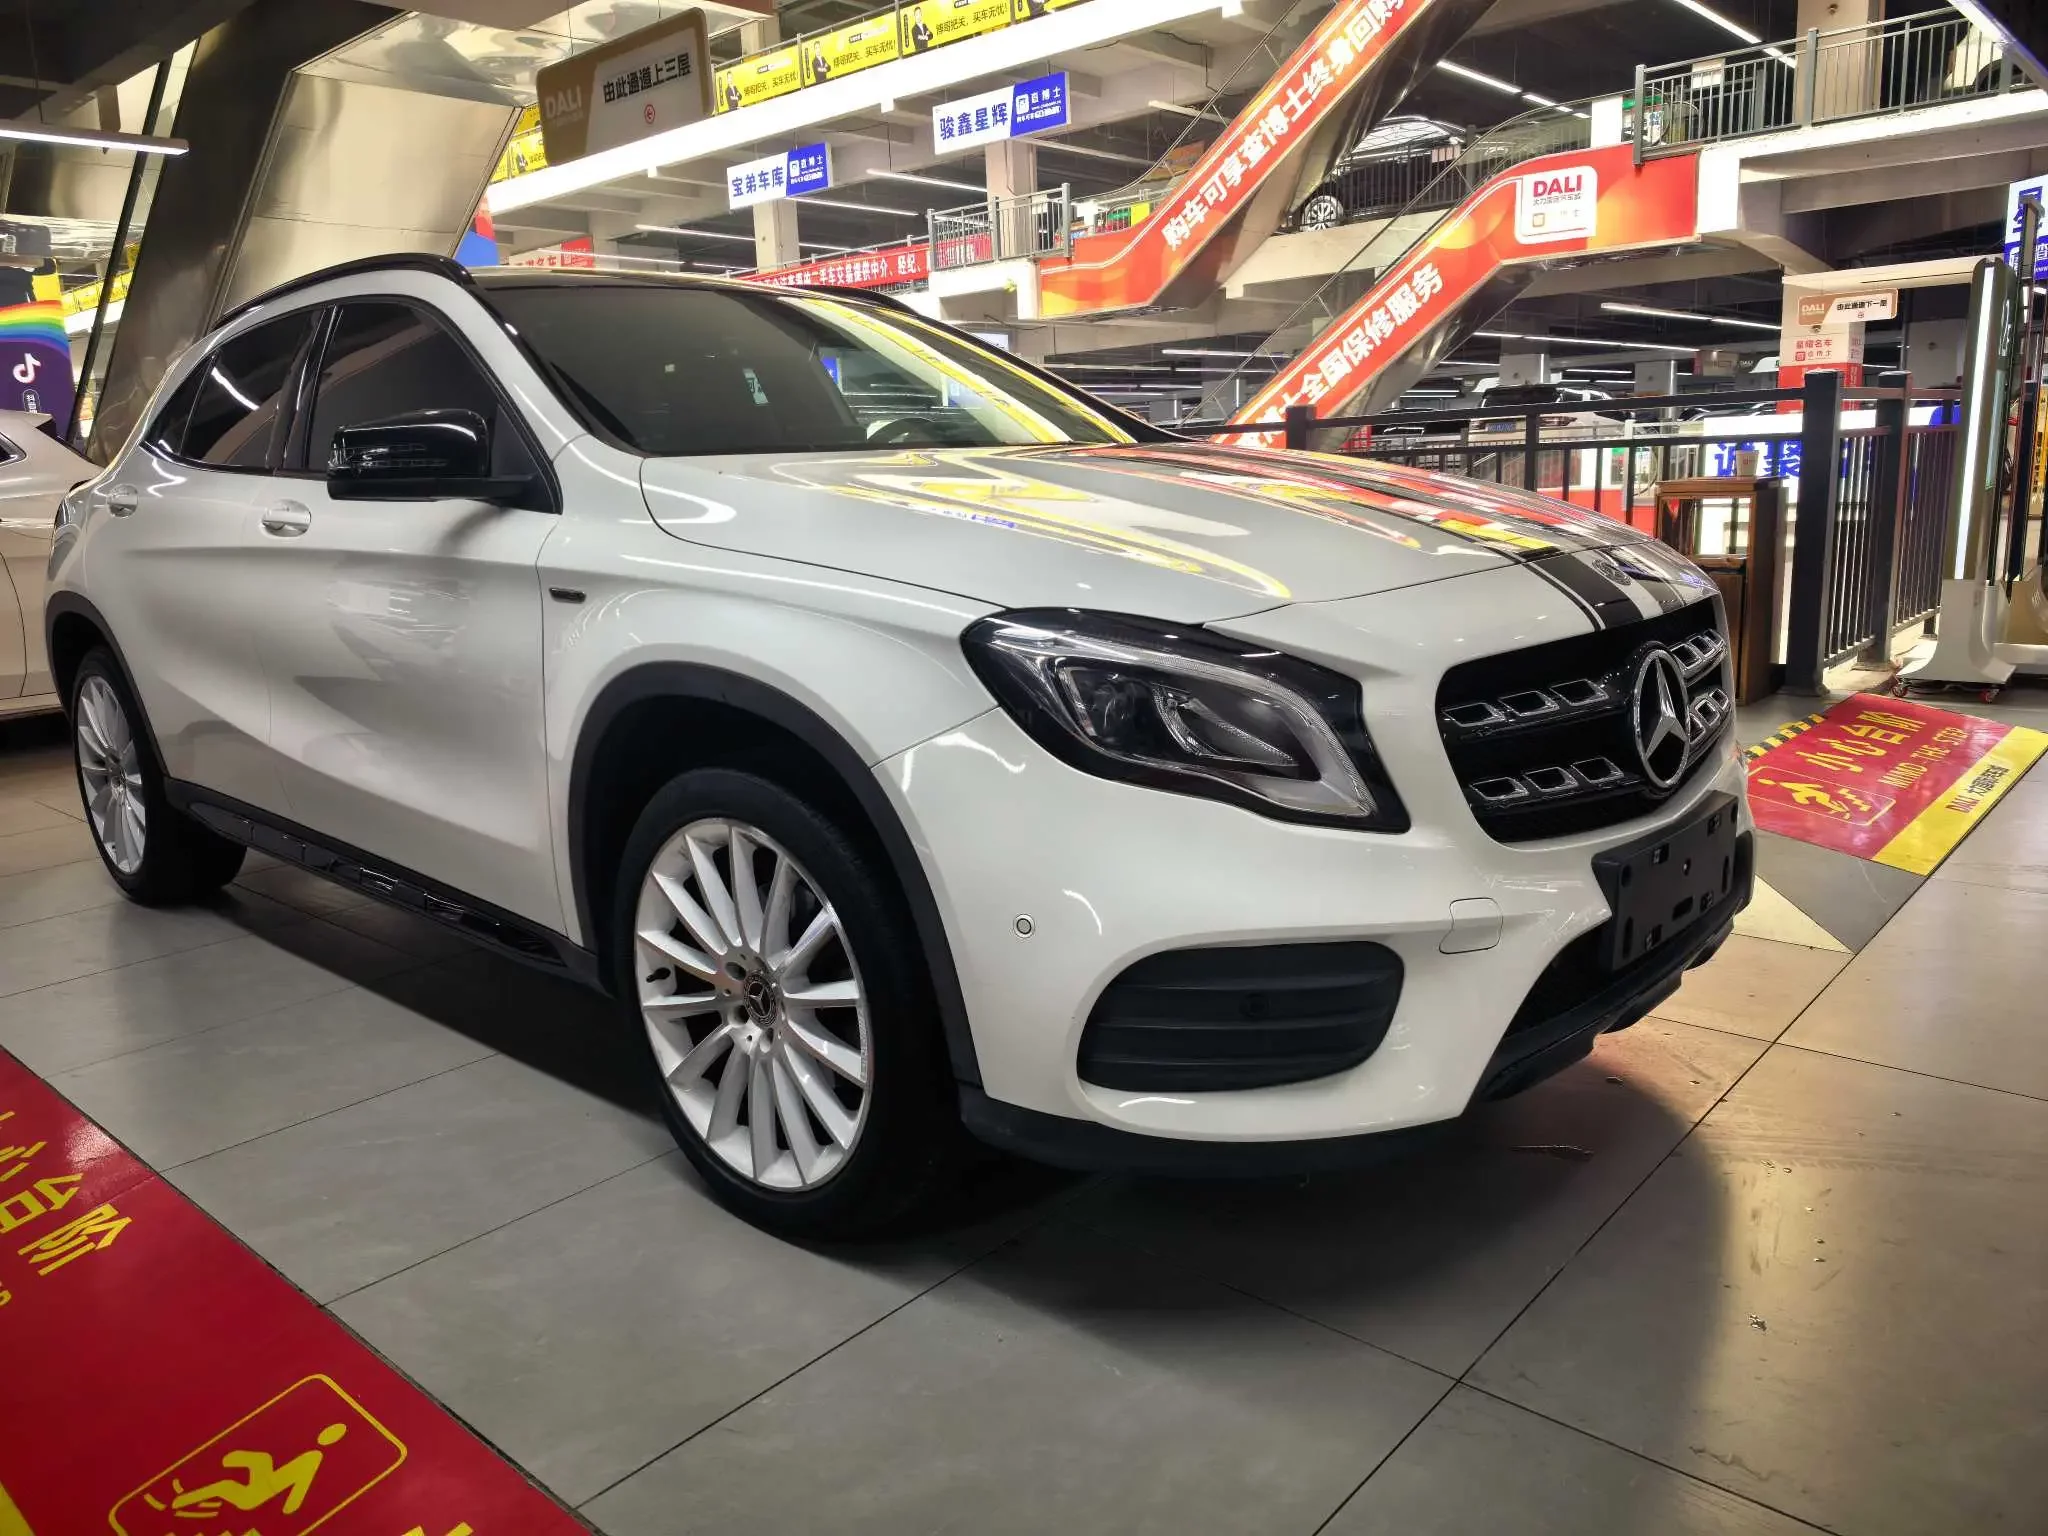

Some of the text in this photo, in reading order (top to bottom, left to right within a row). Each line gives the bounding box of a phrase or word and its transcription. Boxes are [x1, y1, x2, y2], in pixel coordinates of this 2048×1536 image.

[603, 52, 691, 104] 由此通道上三层
[545, 85, 582, 119] DALI
[939, 102, 1008, 141] 骏鑫星辉
[732, 166, 785, 198] 宝弟车库
[1533, 174, 1583, 198] DALI
[1802, 303, 1825, 312] DALI
[1796, 710, 1927, 773] 小心台阶
[1878, 726, 1970, 789] MIND THE STEP
